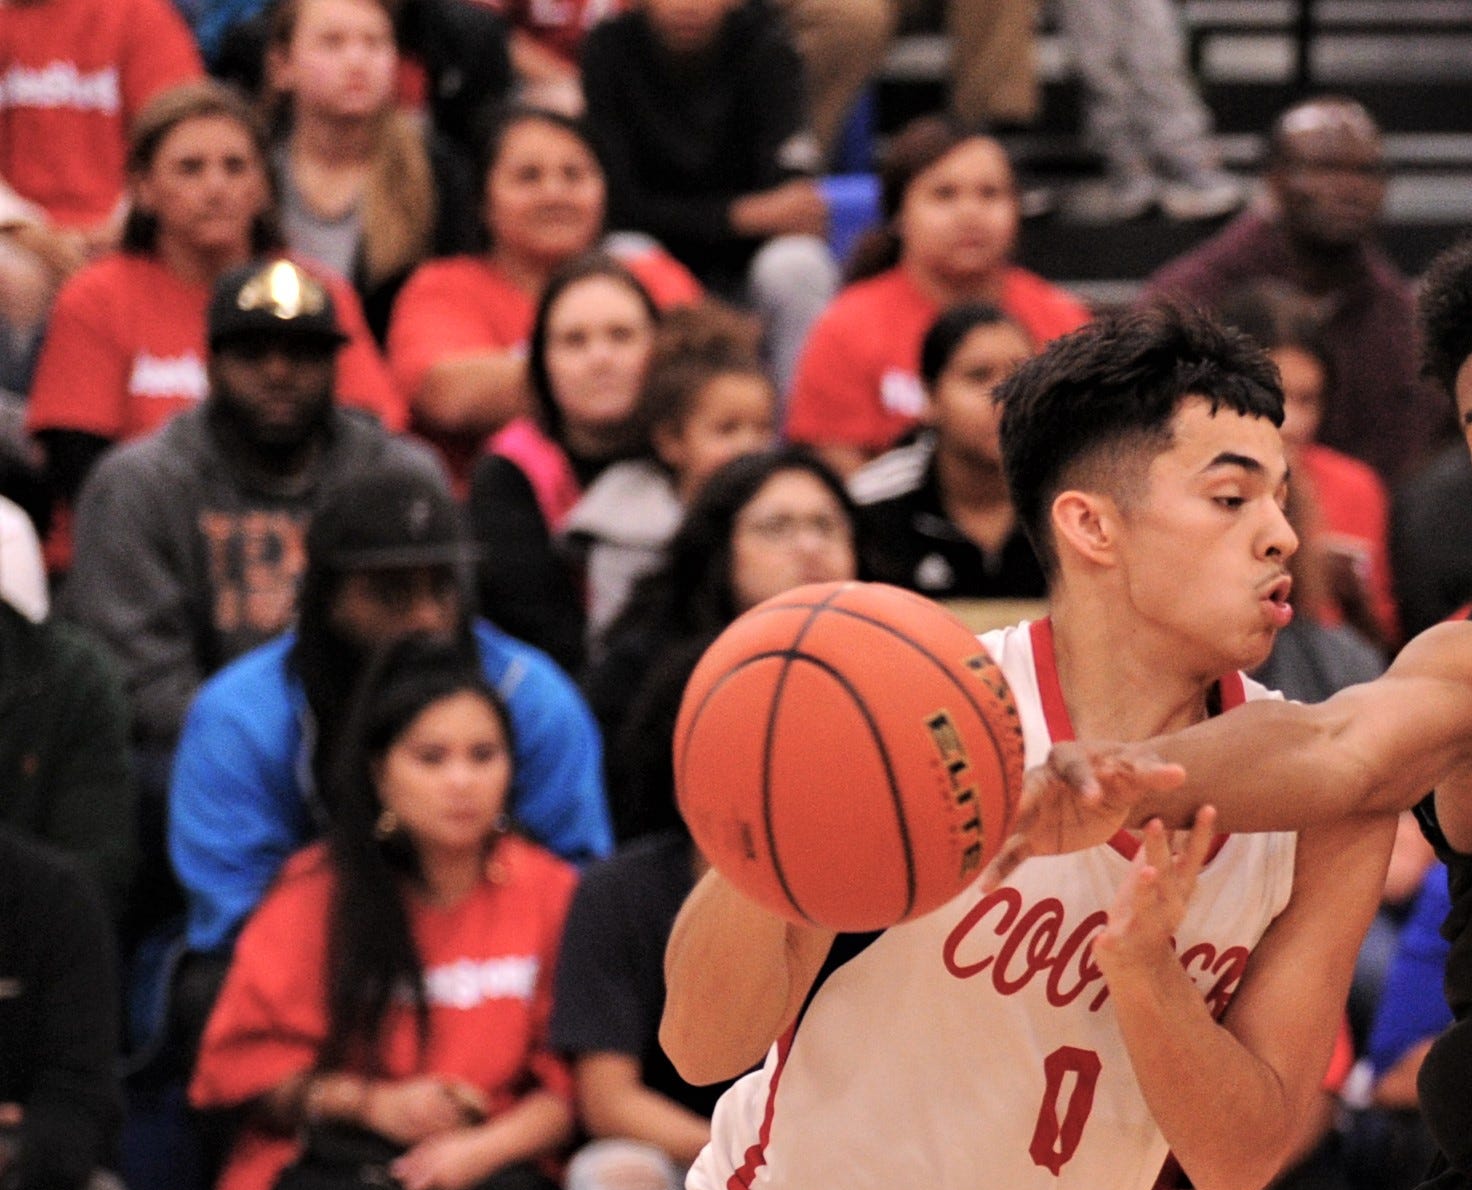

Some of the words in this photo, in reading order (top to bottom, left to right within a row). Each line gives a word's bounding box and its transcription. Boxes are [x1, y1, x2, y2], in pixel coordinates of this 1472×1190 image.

[925, 707, 984, 879] ELITE
[942, 887, 1250, 1025] COO
[1028, 1045, 1102, 1177] 0
